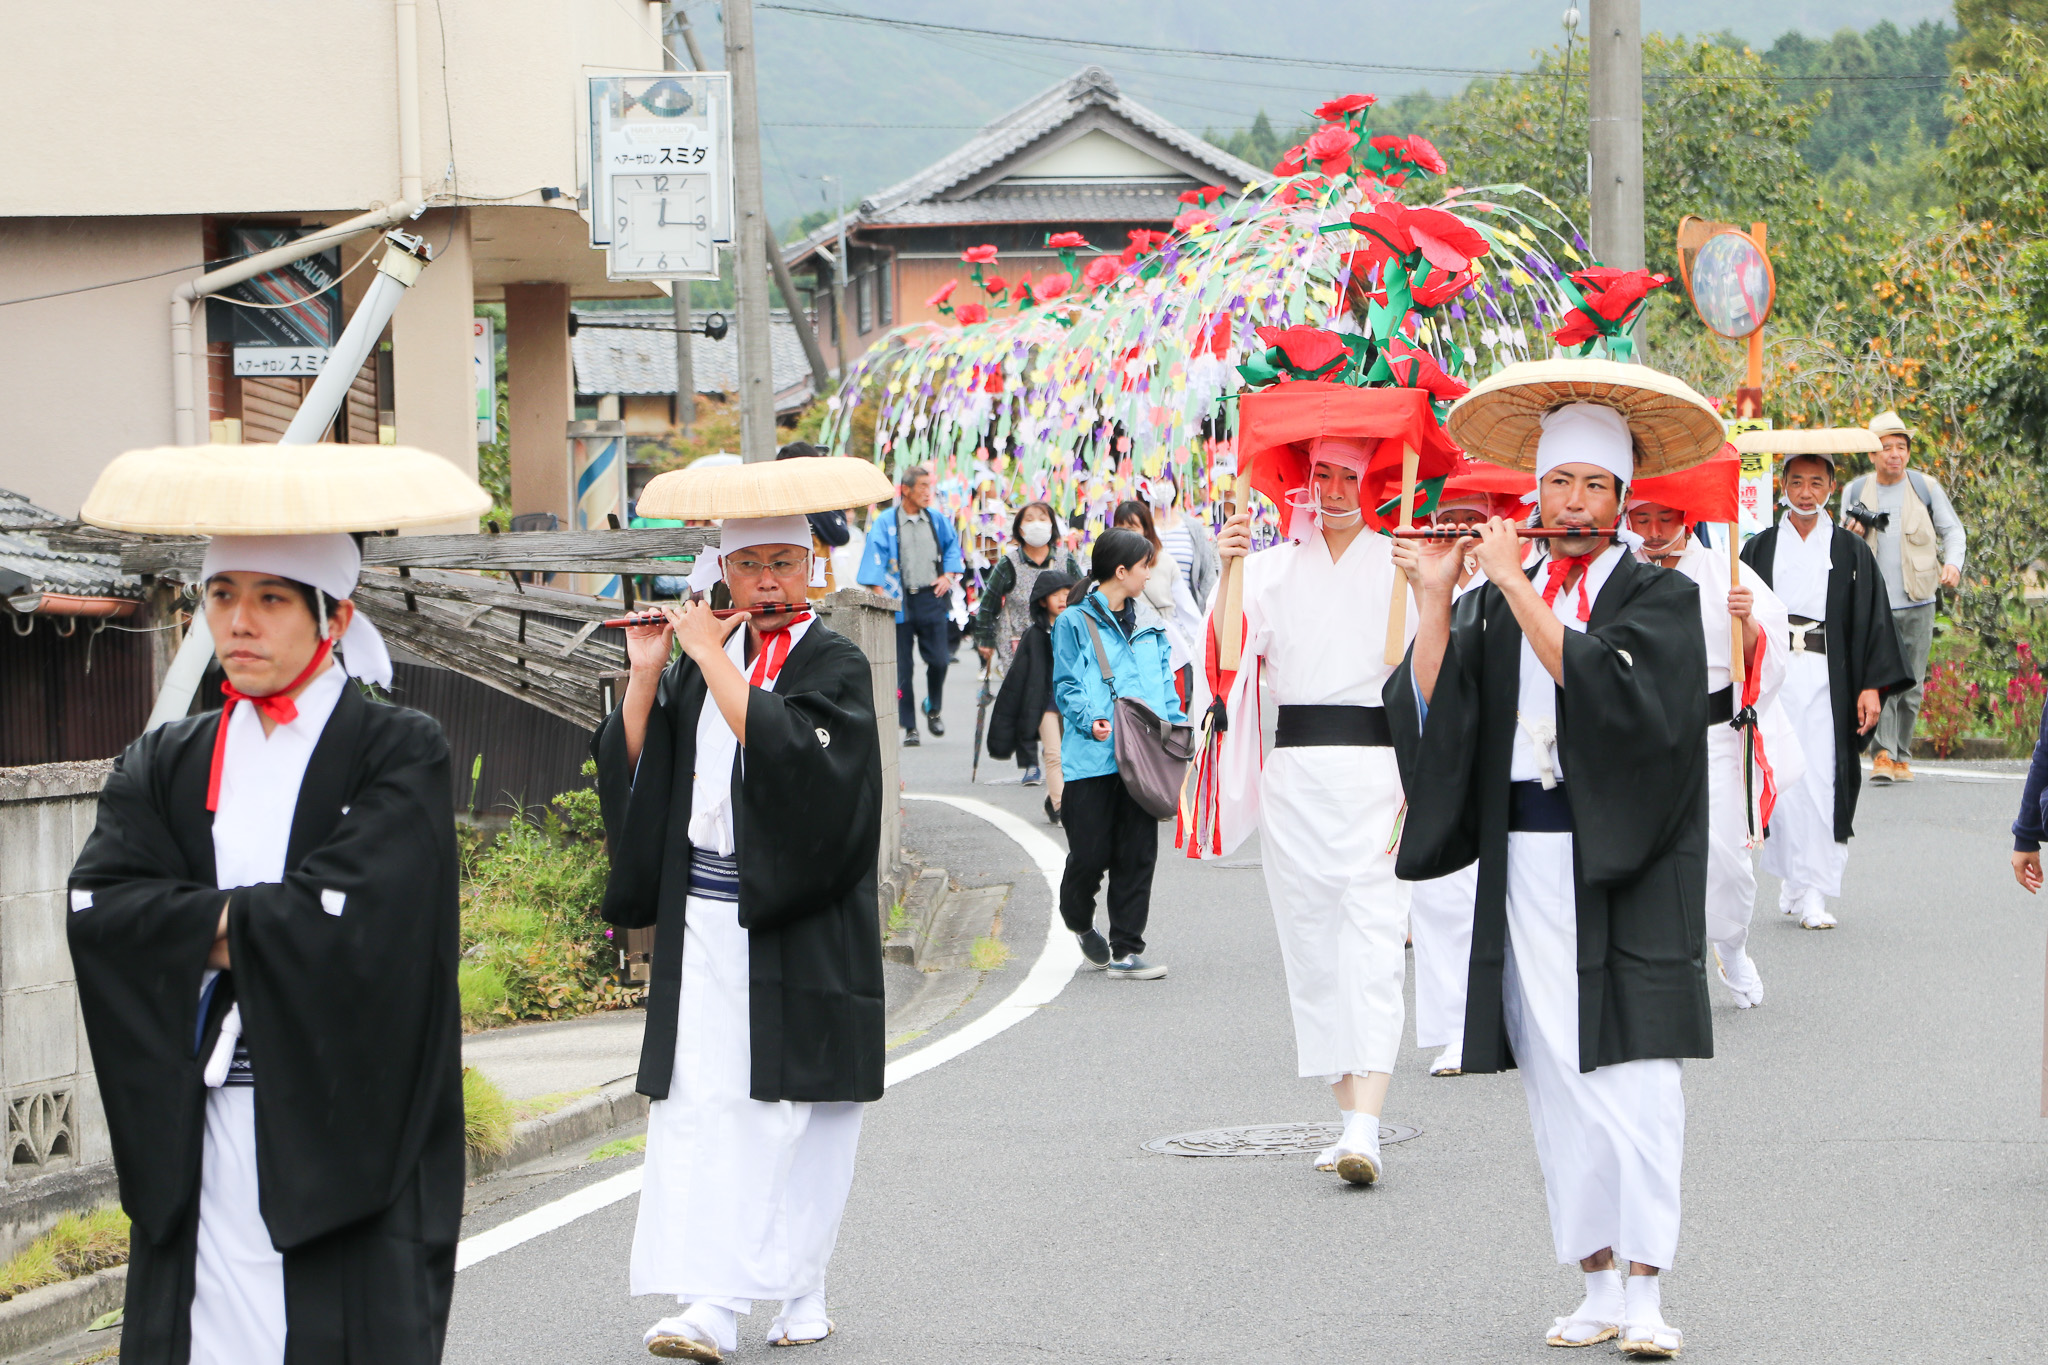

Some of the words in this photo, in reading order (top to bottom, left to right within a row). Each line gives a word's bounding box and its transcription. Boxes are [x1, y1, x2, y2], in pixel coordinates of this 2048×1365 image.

[614, 154, 657, 165] ヘアーサロン
[660, 147, 709, 165] スミダ
[654, 176, 669, 192] 12
[618, 217, 629, 233] 9
[696, 215, 707, 231] 3
[657, 254, 668, 270] 6
[237, 360, 286, 372] ヘアーサロン
[1736, 424, 1764, 472] 意
